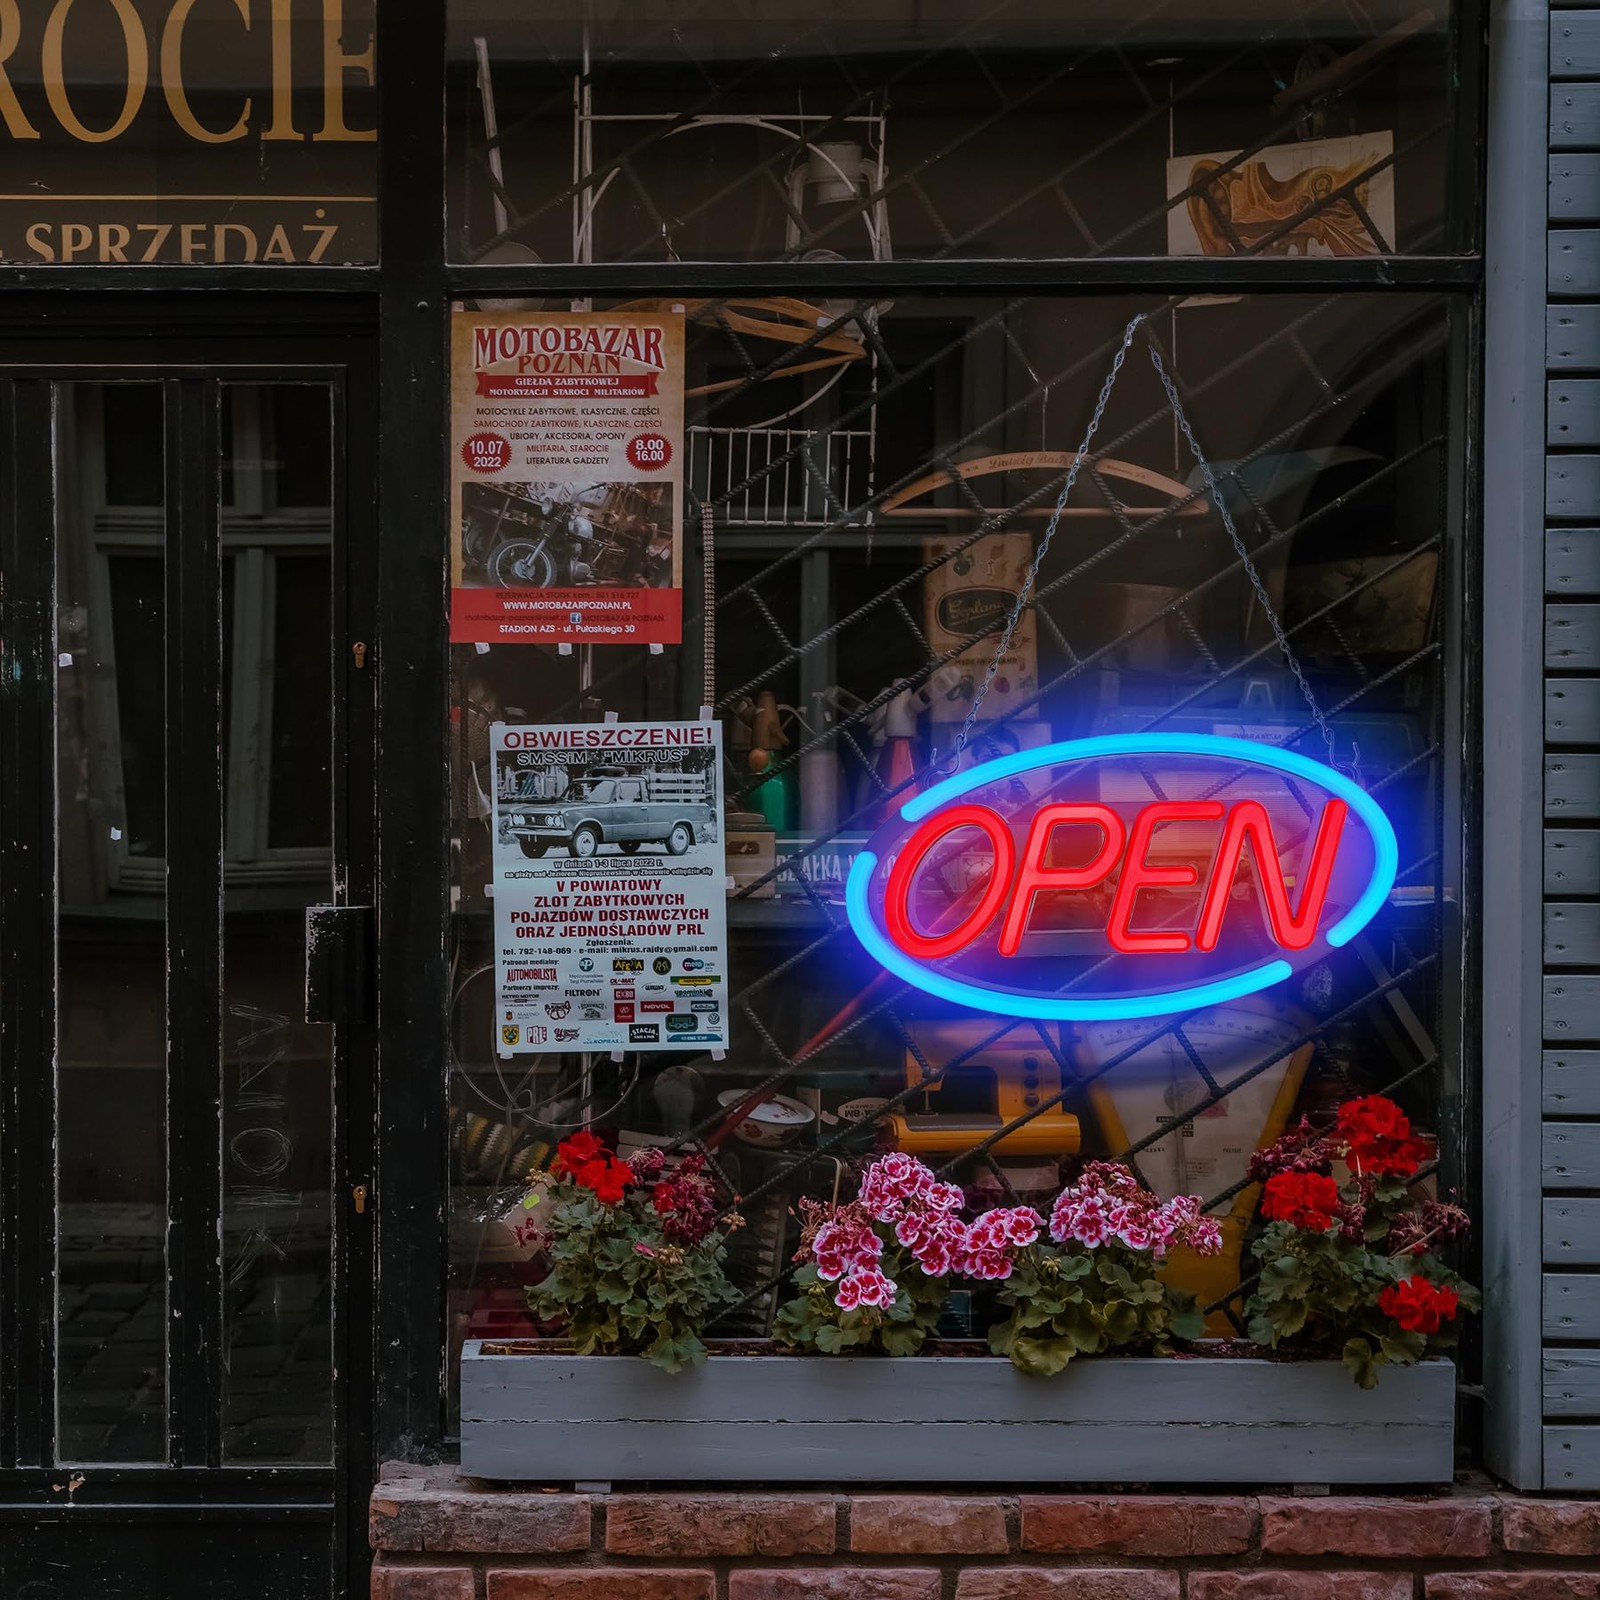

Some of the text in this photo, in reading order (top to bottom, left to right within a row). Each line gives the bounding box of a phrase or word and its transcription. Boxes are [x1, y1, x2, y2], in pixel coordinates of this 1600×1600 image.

[25, 208, 339, 263] SPRZEDAŻ
[474, 327, 665, 370] MOTOBAZAR
[515, 377, 619, 387] GIEŁDA ZABYTKOWEJ
[489, 387, 645, 396] MOTORYZACJI STAROCI MILITARIÓW
[476, 406, 660, 417] MOTOCYKLE ZABYTKOWE, KLASYCZNE, CZĘŚCI
[473, 419, 663, 429] SAMOCHODY ZABYTKOWE, KLASYCZNE, CZĘŚCI
[510, 432, 626, 442] UBIORY, AKCESORIA, OPONY
[469, 440, 504, 454] 10.07
[526, 444, 609, 453] MILITARIA, STAROCIE
[634, 439, 664, 450] 8.00
[526, 457, 571, 465] LITERATURA
[634, 451, 664, 461] 16.00
[473, 457, 502, 467] 2022
[503, 601, 632, 610] WWW.MOTOBAZARPOZNAN.PL
[499, 625, 537, 633] STADION
[539, 625, 556, 633] AZS
[563, 625, 573, 633] ul.
[624, 625, 635, 633] 30
[503, 727, 713, 748] OBWIESZCZENIE!
[517, 751, 587, 766] SMSSiM
[553, 860, 562, 869] w
[564, 859, 593, 868] dniach
[594, 859, 609, 868] 1-3
[610, 859, 632, 869] lipca
[633, 858, 656, 867] 2022
[776, 854, 843, 883] DZAŁKA
[884, 799, 1348, 958] OPEN
[556, 879, 661, 892] V POWIATOWY
[574, 893, 685, 907] ZABYTKOWYCH
[510, 908, 709, 923] POJAZDÓW DOSTAWCZYCH
[515, 922, 705, 938] ORAZ JEDNOŚLADÓW PRL
[586, 938, 634, 947] Zgłoszenia:
[579, 945, 610, 954] e-mail:
[611, 944, 718, 955] mikrus.rajdy@gmail.com
[530, 958, 560, 967] medialny:
[506, 967, 557, 983] AUTOMOBILISTA
[502, 984, 560, 992] Partnerzy imprezy:
[565, 989, 600, 997] FILTRON
[632, 1027, 658, 1037] STACJA
